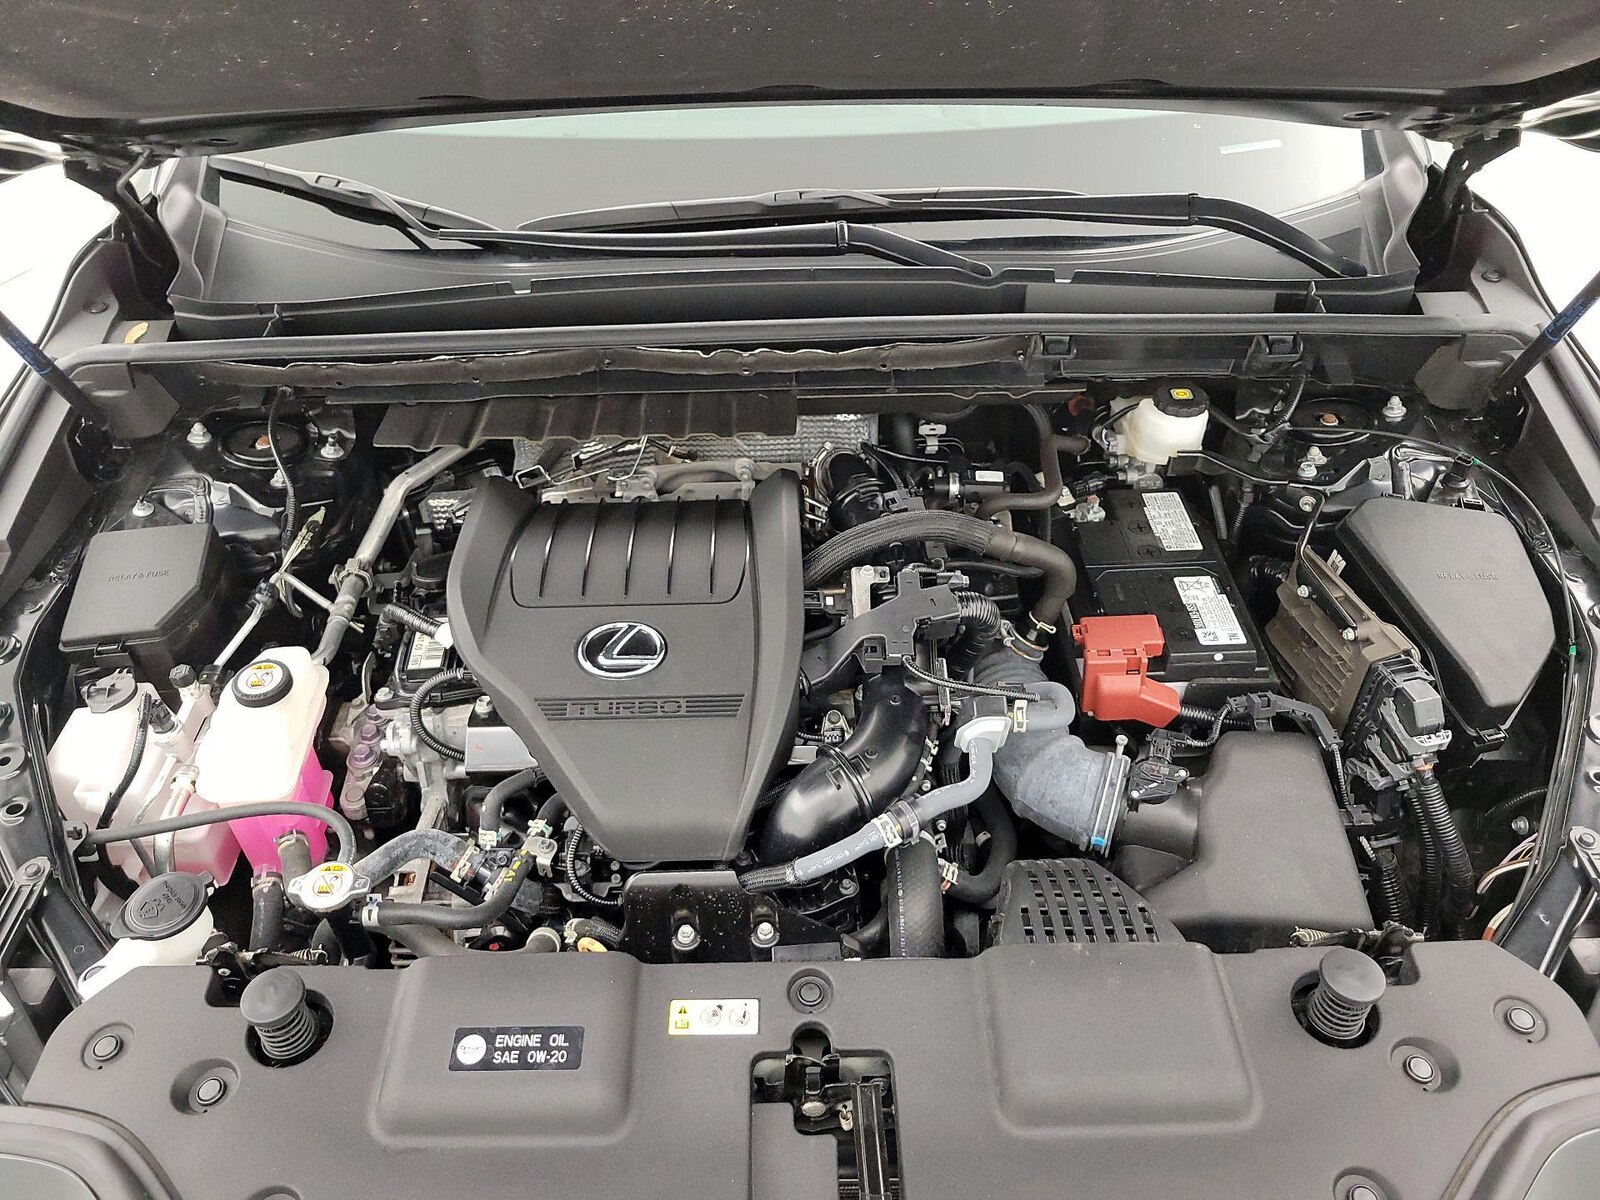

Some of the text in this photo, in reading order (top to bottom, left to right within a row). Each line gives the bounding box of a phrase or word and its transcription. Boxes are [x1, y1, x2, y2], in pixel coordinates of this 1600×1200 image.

[108, 573, 137, 582] RELAY
[147, 569, 169, 578] FUSE
[1474, 572, 1498, 580] FUSE
[569, 700, 683, 716] TURBO
[495, 1033, 569, 1048] ENGINE OIL
[492, 1050, 568, 1064] SAE 0W-20
